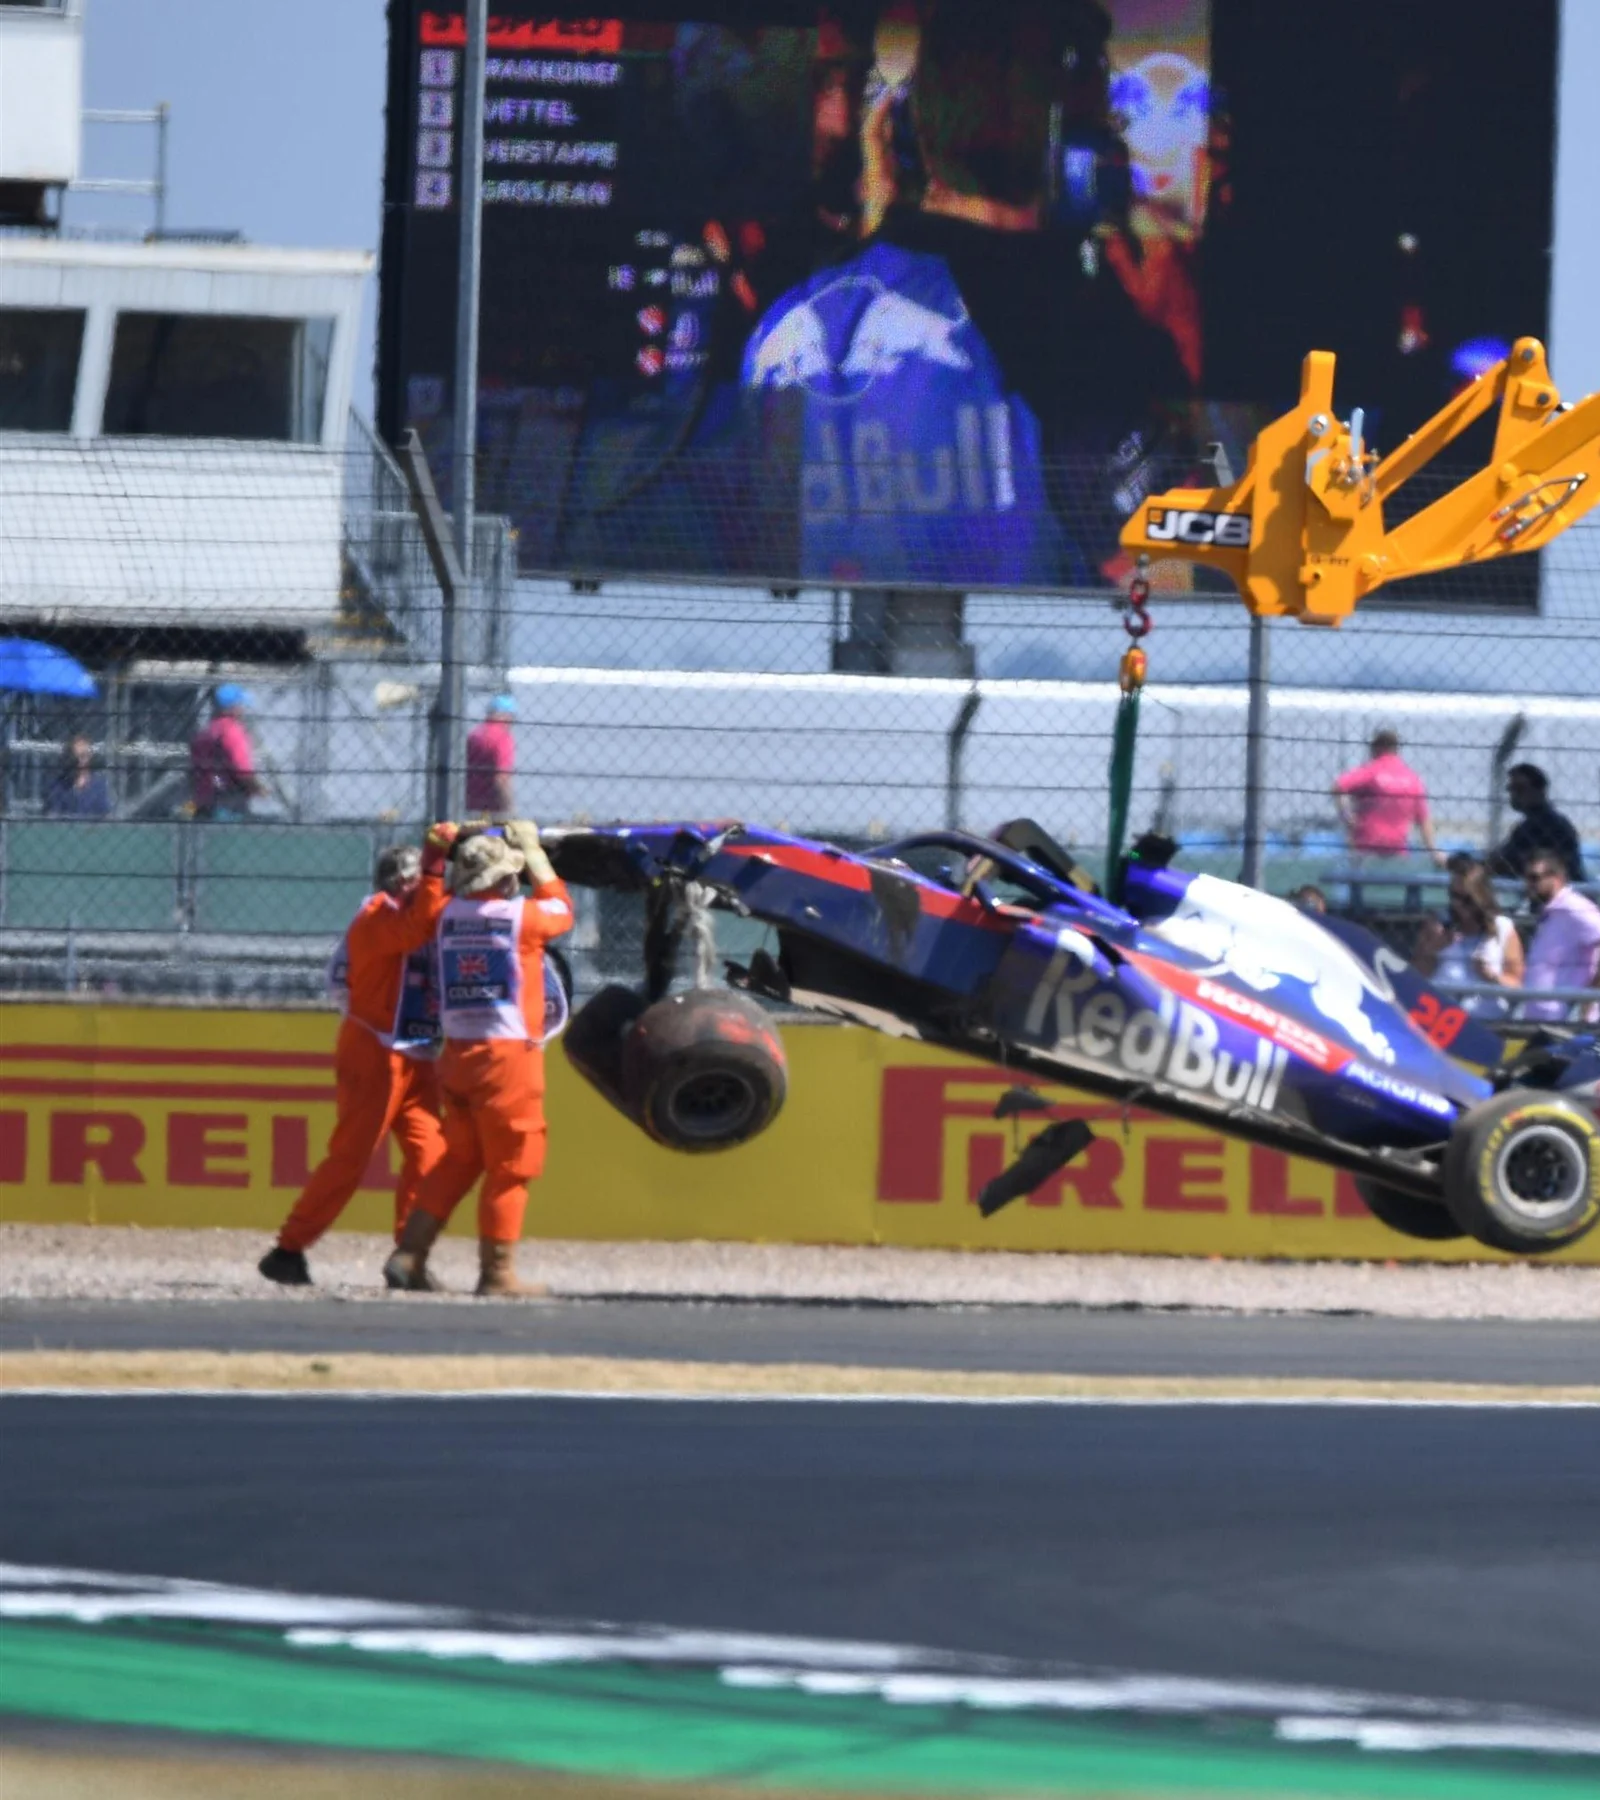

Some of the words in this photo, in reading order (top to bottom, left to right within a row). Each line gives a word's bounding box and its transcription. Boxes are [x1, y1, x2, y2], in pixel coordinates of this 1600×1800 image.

[1147, 510, 1250, 546] JCB
[1195, 977, 1331, 1058] HONDA
[1408, 992, 1470, 1050] 28
